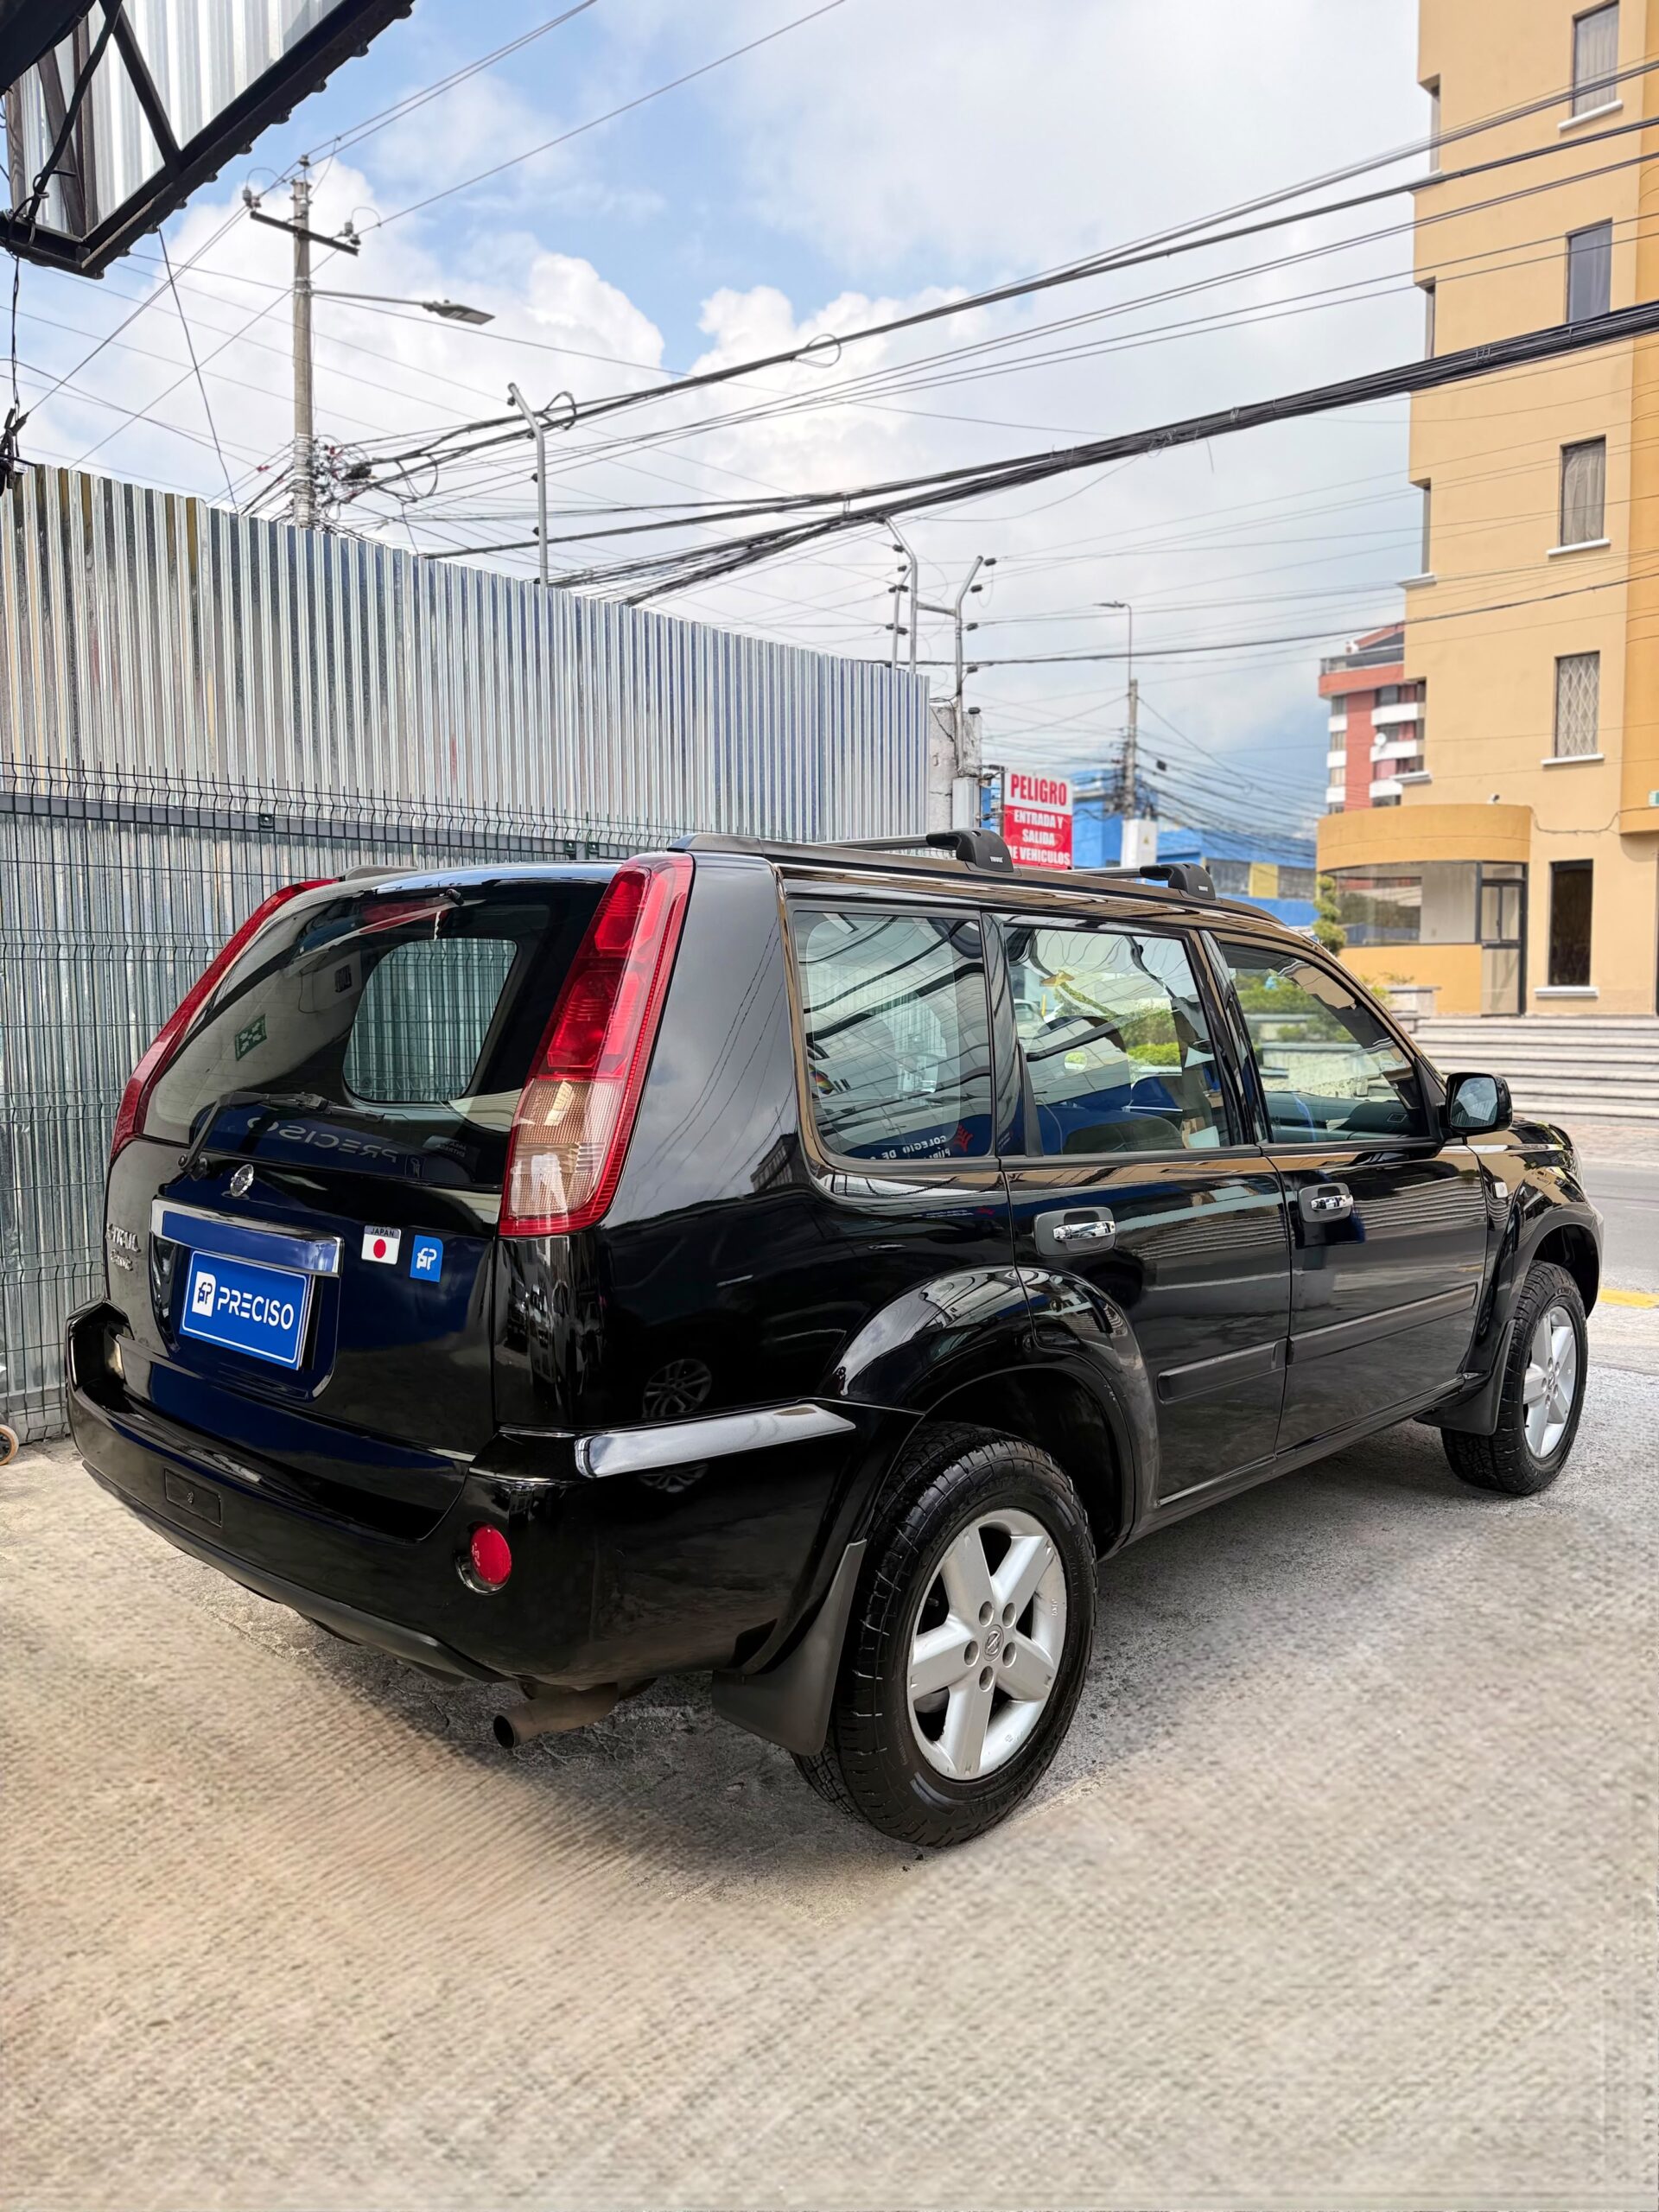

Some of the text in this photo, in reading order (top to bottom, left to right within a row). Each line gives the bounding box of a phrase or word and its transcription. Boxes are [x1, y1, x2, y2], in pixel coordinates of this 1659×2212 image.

[1010, 773, 1067, 806] PELIGRO
[1014, 809, 1064, 830] ENTRADA Y
[1021, 828, 1056, 846] SALIDA
[1020, 847, 1071, 866] VEHICULOS
[370, 1227, 395, 1237] JAPAN
[217, 1286, 295, 1331] PRECISO
